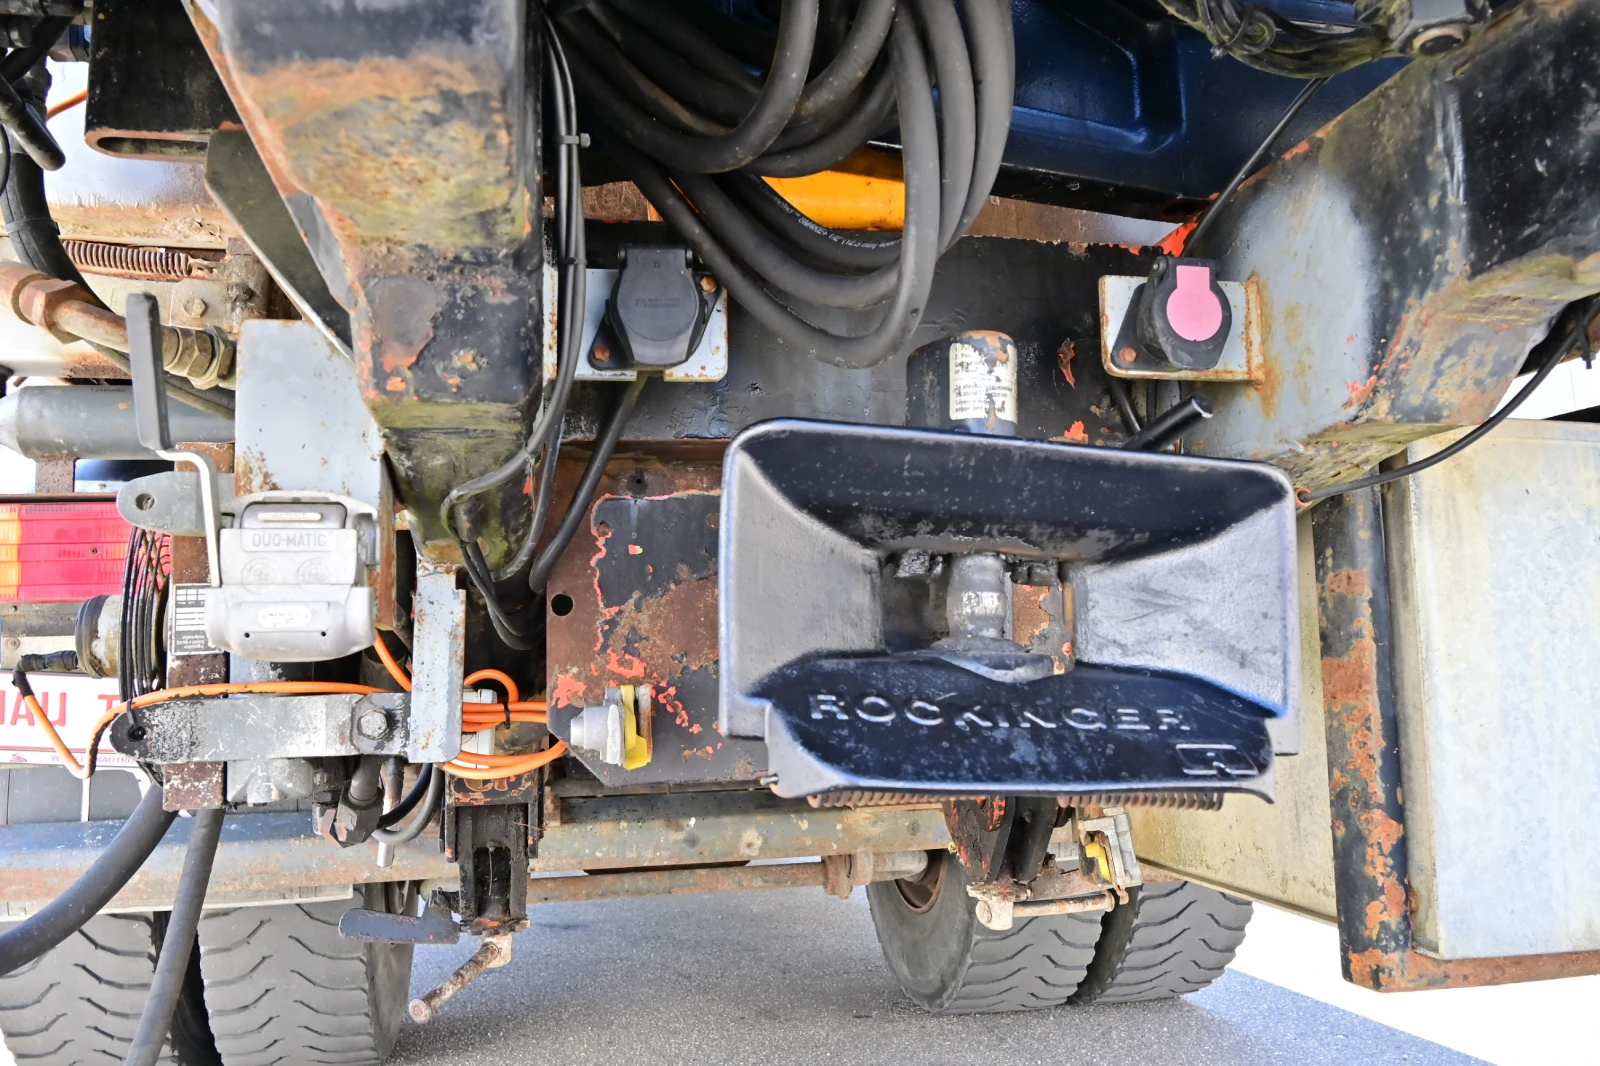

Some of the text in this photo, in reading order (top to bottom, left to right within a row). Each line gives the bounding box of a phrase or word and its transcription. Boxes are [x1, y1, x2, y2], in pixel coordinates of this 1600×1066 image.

[251, 533, 329, 548] DUO-MATIC
[0, 689, 67, 727] AU
[808, 693, 1192, 733] ROCKINGER
